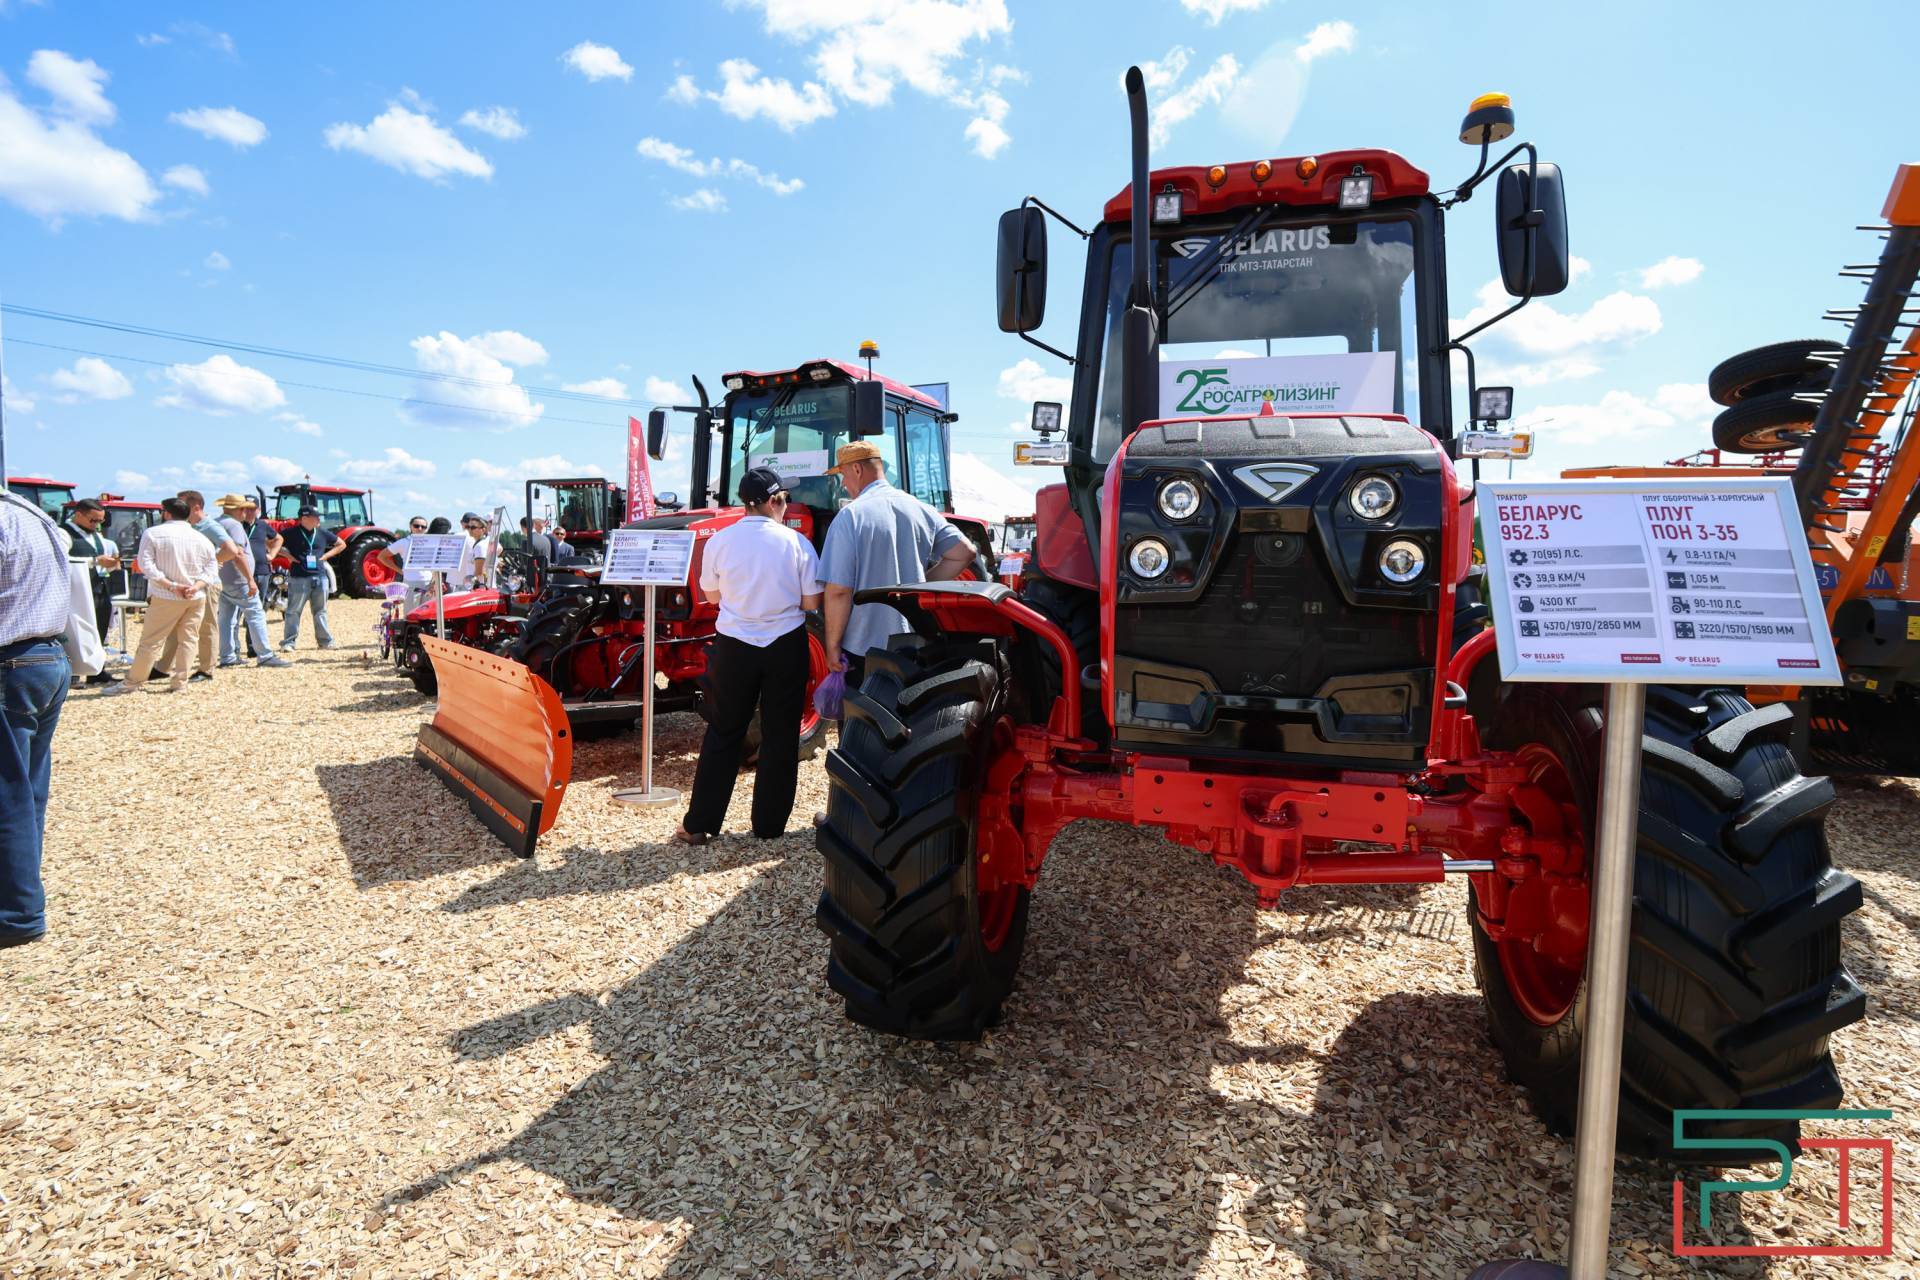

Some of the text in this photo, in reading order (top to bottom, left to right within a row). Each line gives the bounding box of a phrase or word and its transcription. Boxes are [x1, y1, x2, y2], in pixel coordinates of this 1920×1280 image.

[1219, 257, 1313, 273] ТПК МТЗ-ТАТАРСТАН
[1175, 368, 1231, 415] 25
[774, 402, 817, 417] BELARUS
[1663, 493, 1709, 502] ОБОРОТНЫЙ
[1711, 493, 1765, 502] 3-КОРПУСНЫЙ
[1498, 505, 1583, 522] БЕЛАРУС
[1646, 506, 1694, 521] ПЛУГ
[1501, 524, 1550, 540] 952.3
[1651, 524, 1739, 541] ПОН 3-35
[1531, 549, 1583, 560] 70(95) Л.С.
[1714, 551, 1737, 560] ГА/Ч
[1535, 572, 1586, 584] 39,9 КМ/Ч
[1689, 574, 1719, 584] 1,05 М
[1539, 597, 1578, 606] 4300 КГ
[1694, 599, 1742, 609] 90-110 Л.С
[1543, 620, 1641, 631] 4370/1970/2850 ММ
[1775, 625, 1795, 635] ММ
